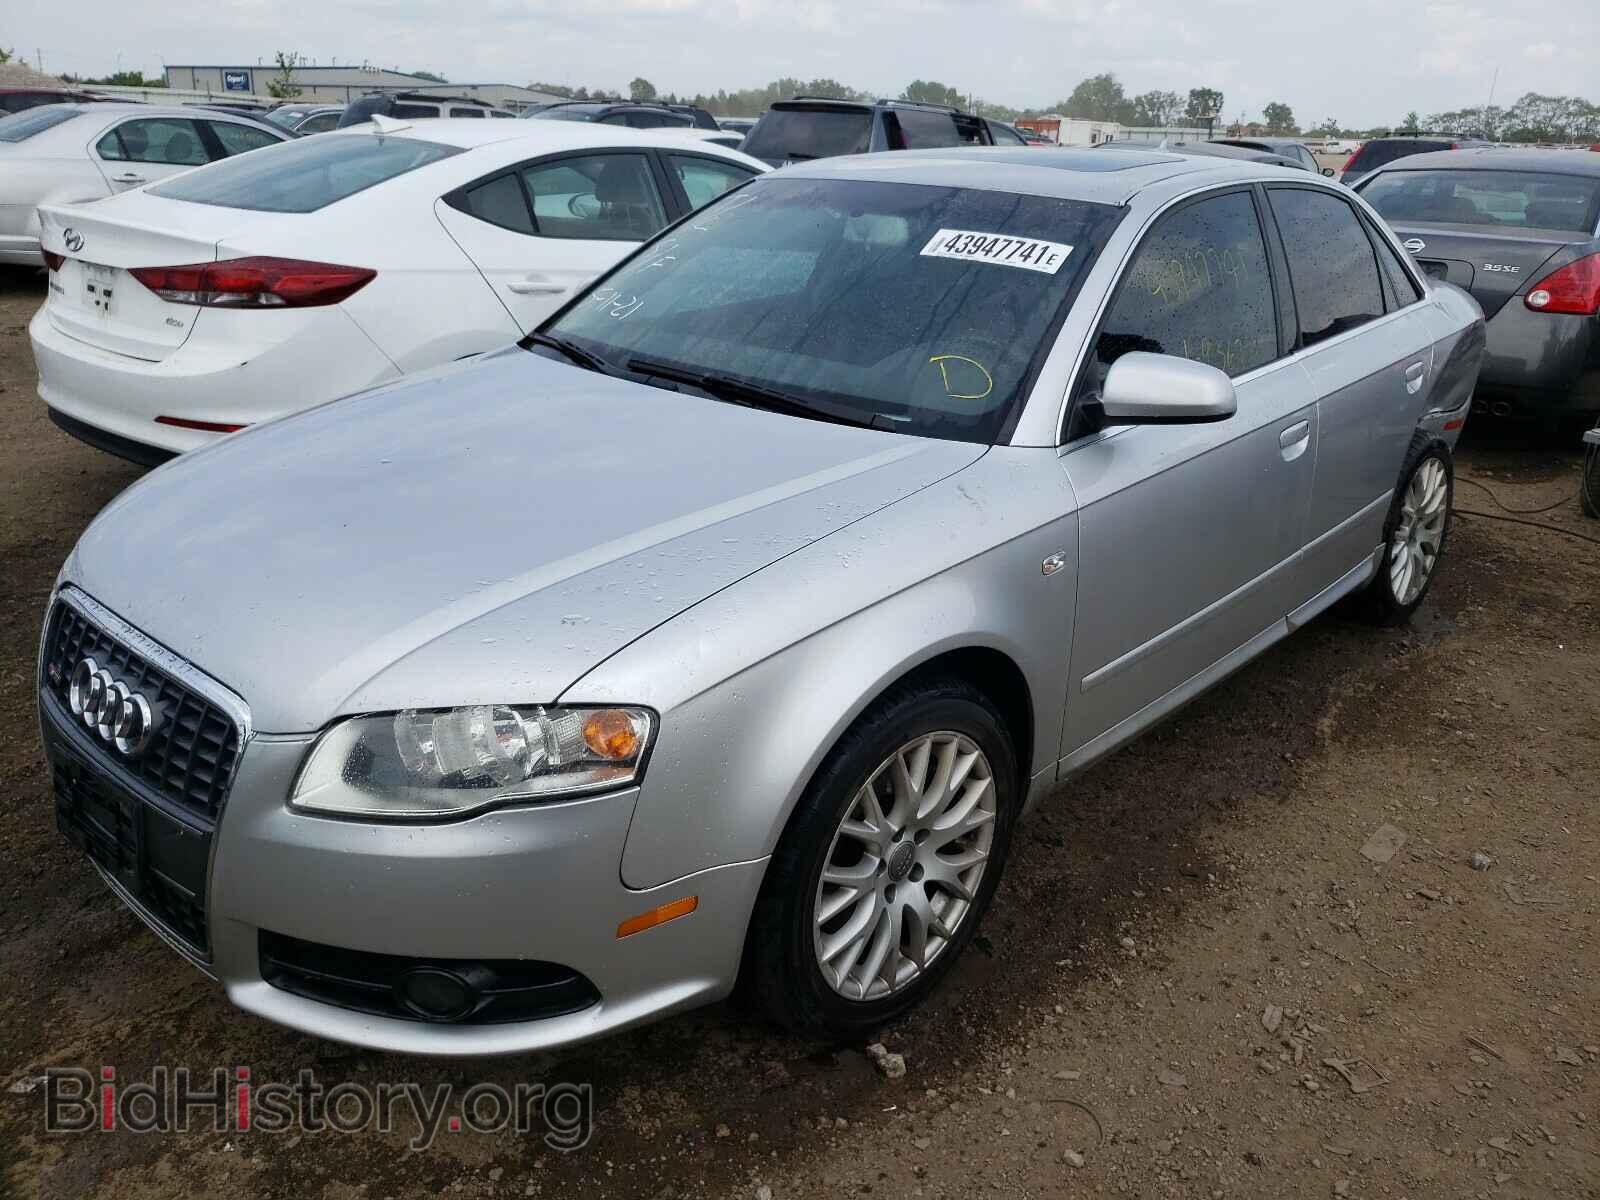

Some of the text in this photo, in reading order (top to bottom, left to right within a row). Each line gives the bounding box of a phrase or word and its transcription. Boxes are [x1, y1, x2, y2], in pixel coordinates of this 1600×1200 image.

[944, 233, 1050, 265] 43947741
[1046, 253, 1059, 266] E
[928, 354, 993, 399] D
